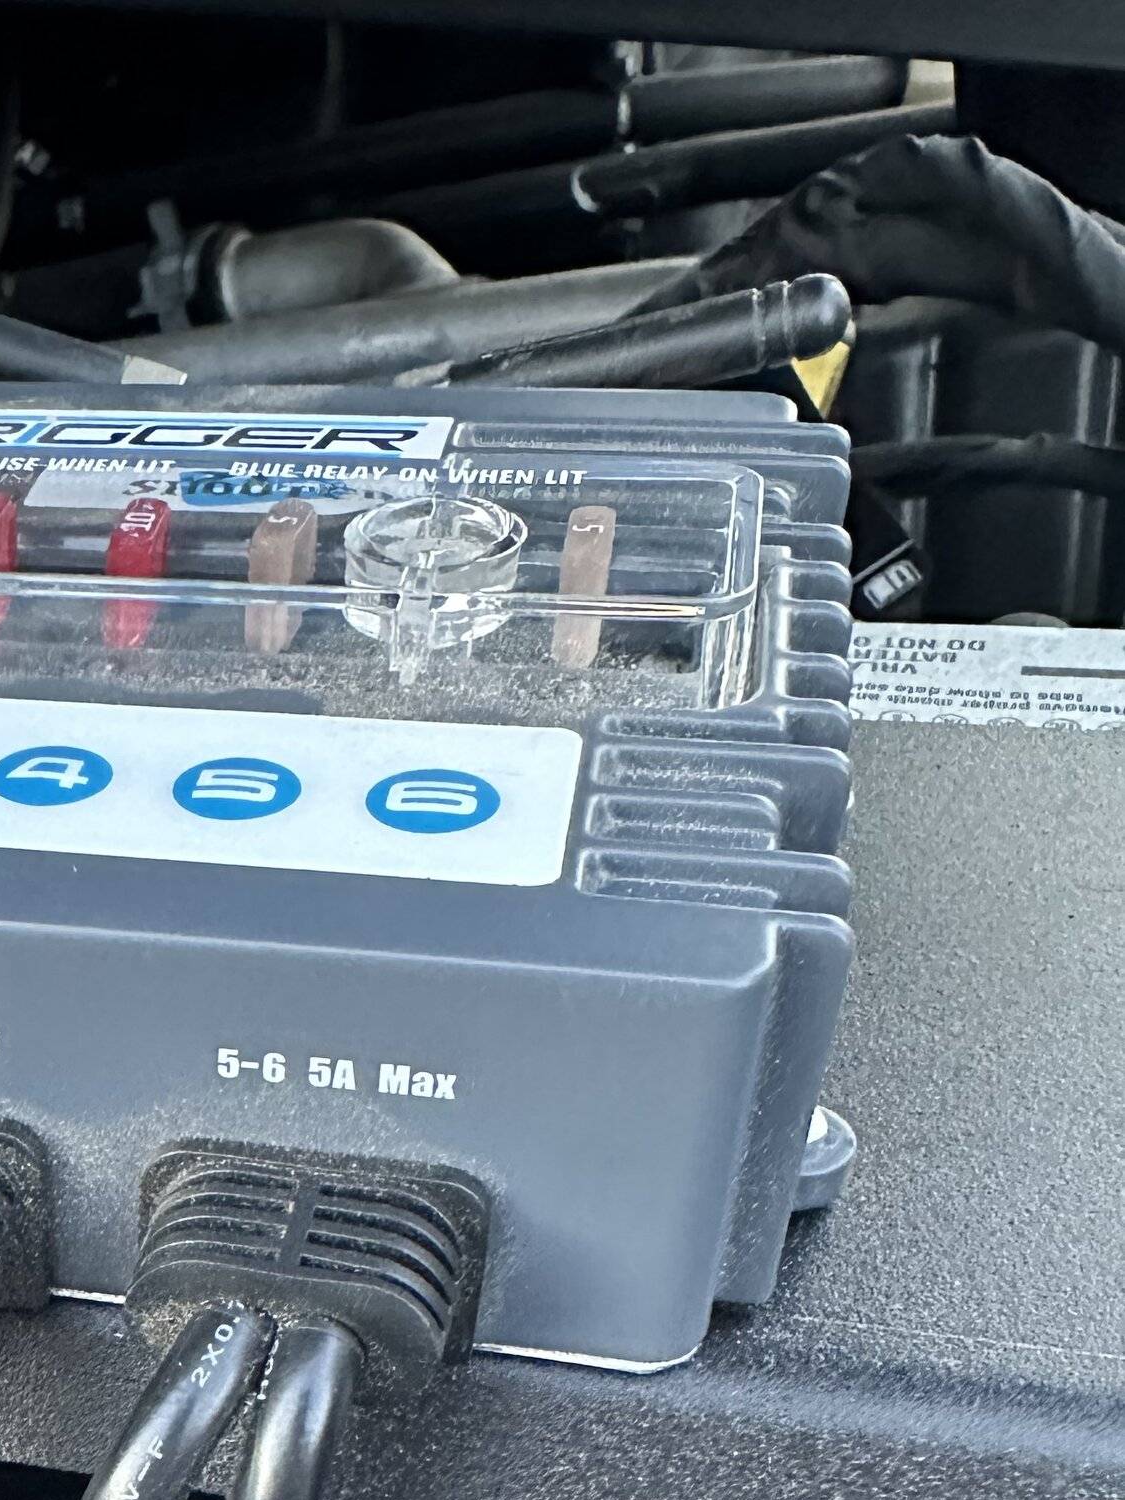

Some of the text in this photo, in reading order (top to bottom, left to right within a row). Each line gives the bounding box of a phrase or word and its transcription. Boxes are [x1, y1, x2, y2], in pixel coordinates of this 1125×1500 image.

[46, 457, 128, 473] WHEN
[133, 459, 177, 474] LIT
[228, 461, 588, 485] BLUE RELAY ON WHEN LIT
[119, 511, 156, 532] 10
[884, 637, 937, 650] NOT
[947, 638, 986, 651] DO
[5, 756, 89, 789] 4
[191, 769, 278, 802] 5
[385, 780, 476, 815] 6
[217, 1047, 458, 1100] 5-6 5A Max
